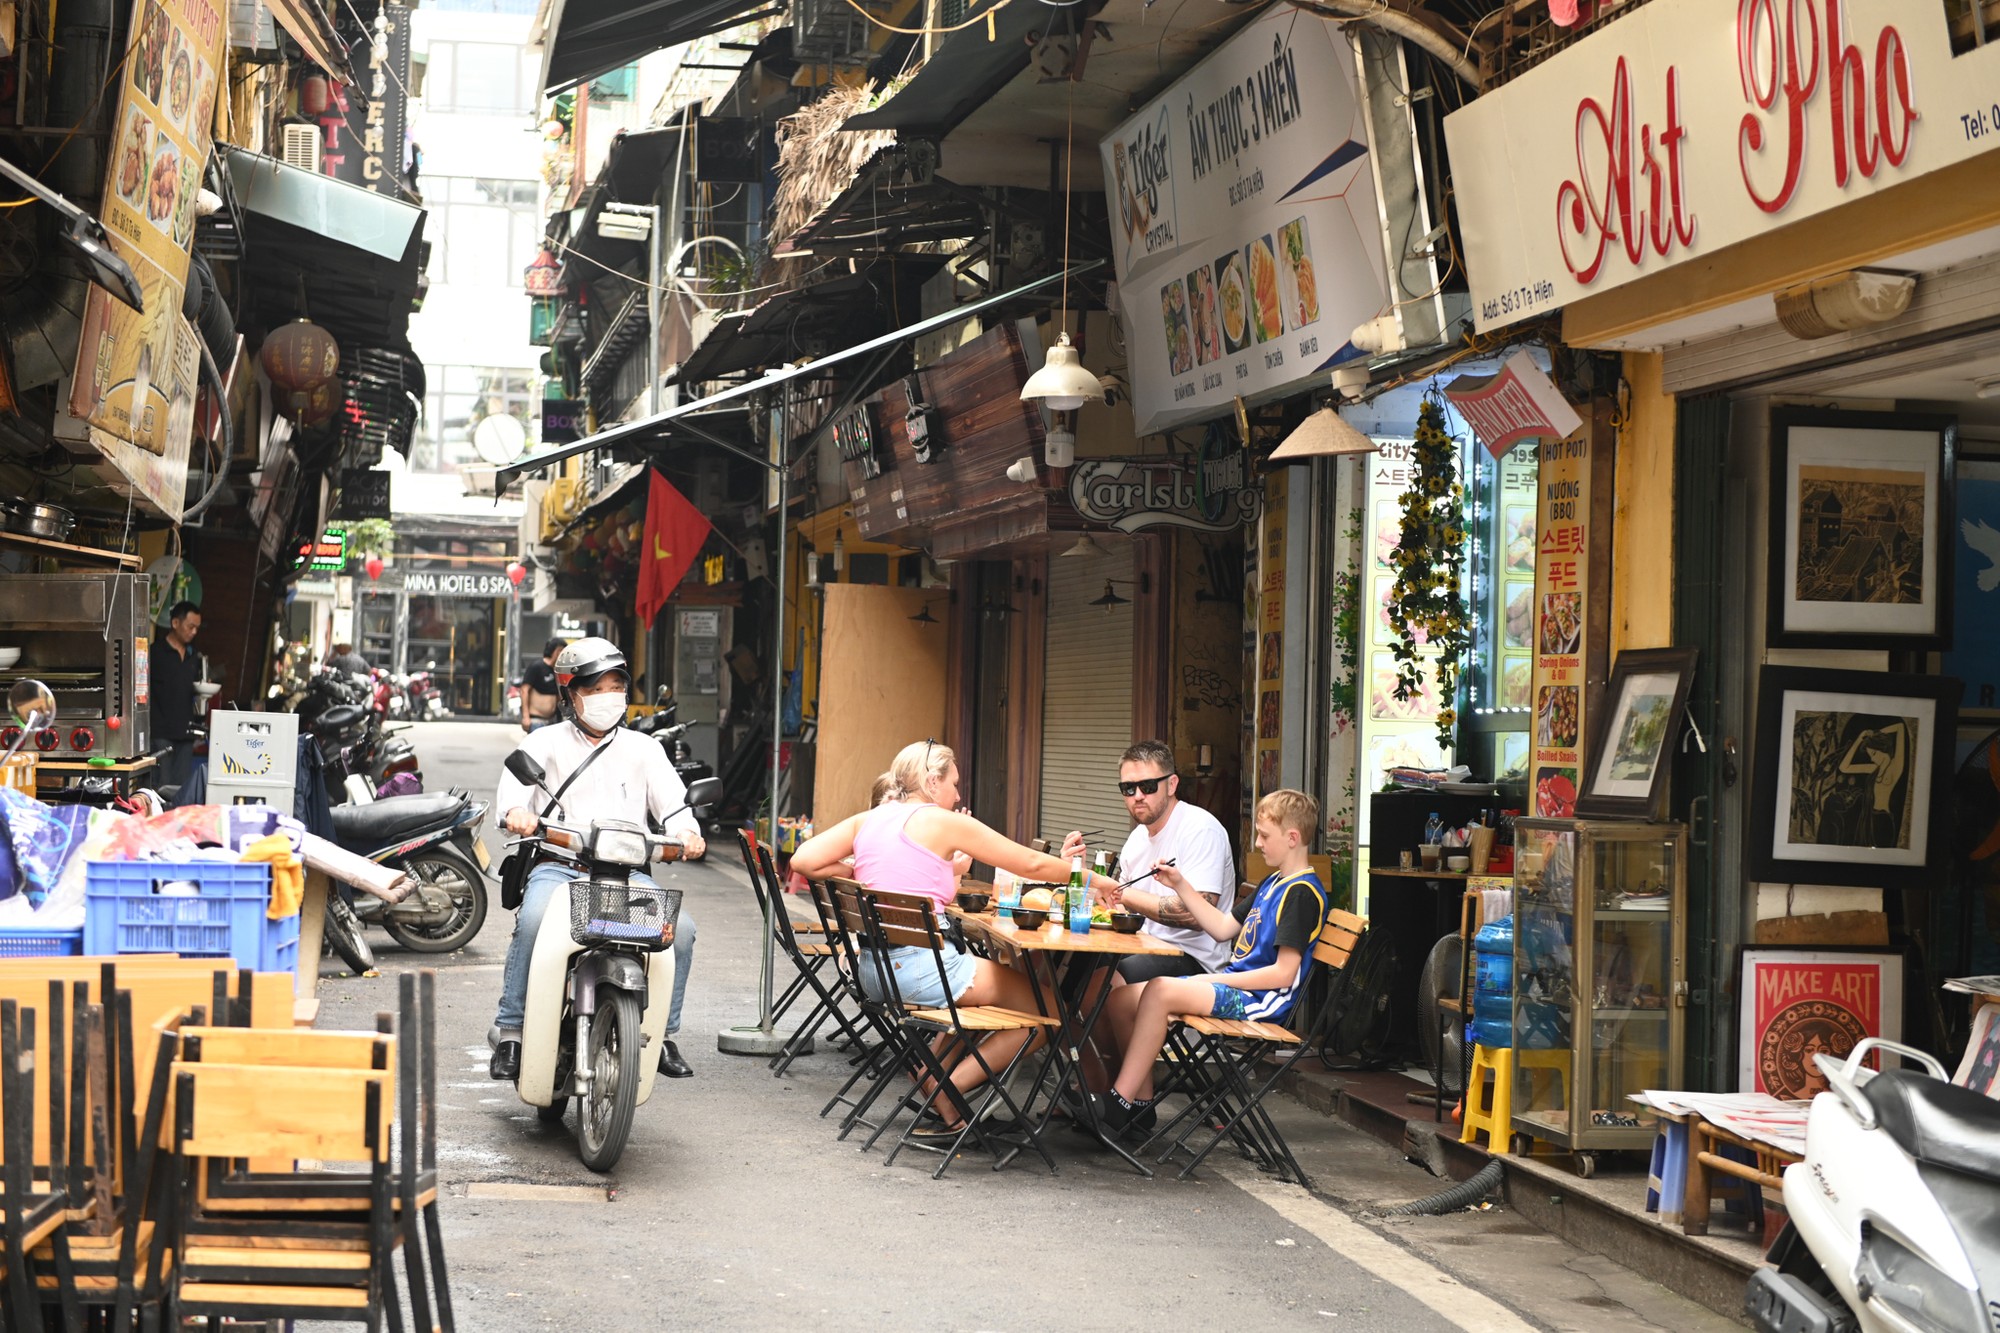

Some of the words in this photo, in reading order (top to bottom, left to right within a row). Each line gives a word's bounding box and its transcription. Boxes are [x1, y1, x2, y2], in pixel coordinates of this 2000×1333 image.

[1187, 92, 1212, 181] ẨM
[1208, 85, 1249, 168] THỰC
[1247, 76, 1260, 142] 3
[1257, 32, 1302, 136] MIỀN
[1960, 109, 1989, 141] Tel:
[1555, 54, 1698, 285] Art
[1737, 0, 1921, 214] Pho
[1128, 121, 1170, 218] Tiger
[1145, 220, 1174, 252] CRYSTAL
[1482, 298, 1501, 322] Add:
[1501, 289, 1514, 315] Số
[1513, 291, 1521, 310] 3
[1520, 287, 1533, 311] Tạ
[1533, 280, 1554, 304] Hiện
[1454, 396, 1516, 447] HANOI
[1493, 377, 1552, 430] BEER
[1379, 442, 1411, 461] City
[1542, 443, 1564, 463] (HOT
[1565, 438, 1588, 460] POT)
[1202, 449, 1244, 498] TUBORG
[1069, 460, 1264, 524] Carlsbg
[1547, 477, 1580, 502] NƯỚNG
[1549, 501, 1576, 521] (BBQ)
[1541, 524, 1586, 555] 스트릿
[403, 574, 436, 591] MINA
[439, 575, 478, 593] HOTEL
[489, 576, 514, 594] SPA
[1547, 561, 1578, 591] 푸드
[1539, 656, 1558, 669] Spring
[1559, 656, 1580, 668] Onions
[1551, 669, 1558, 680] &
[1558, 668, 1567, 680] Oil
[245, 738, 265, 749] Tiger
[1558, 751, 1577, 763] Snails
[1759, 968, 1824, 1026] MAKE
[1829, 972, 1875, 1022] ART
